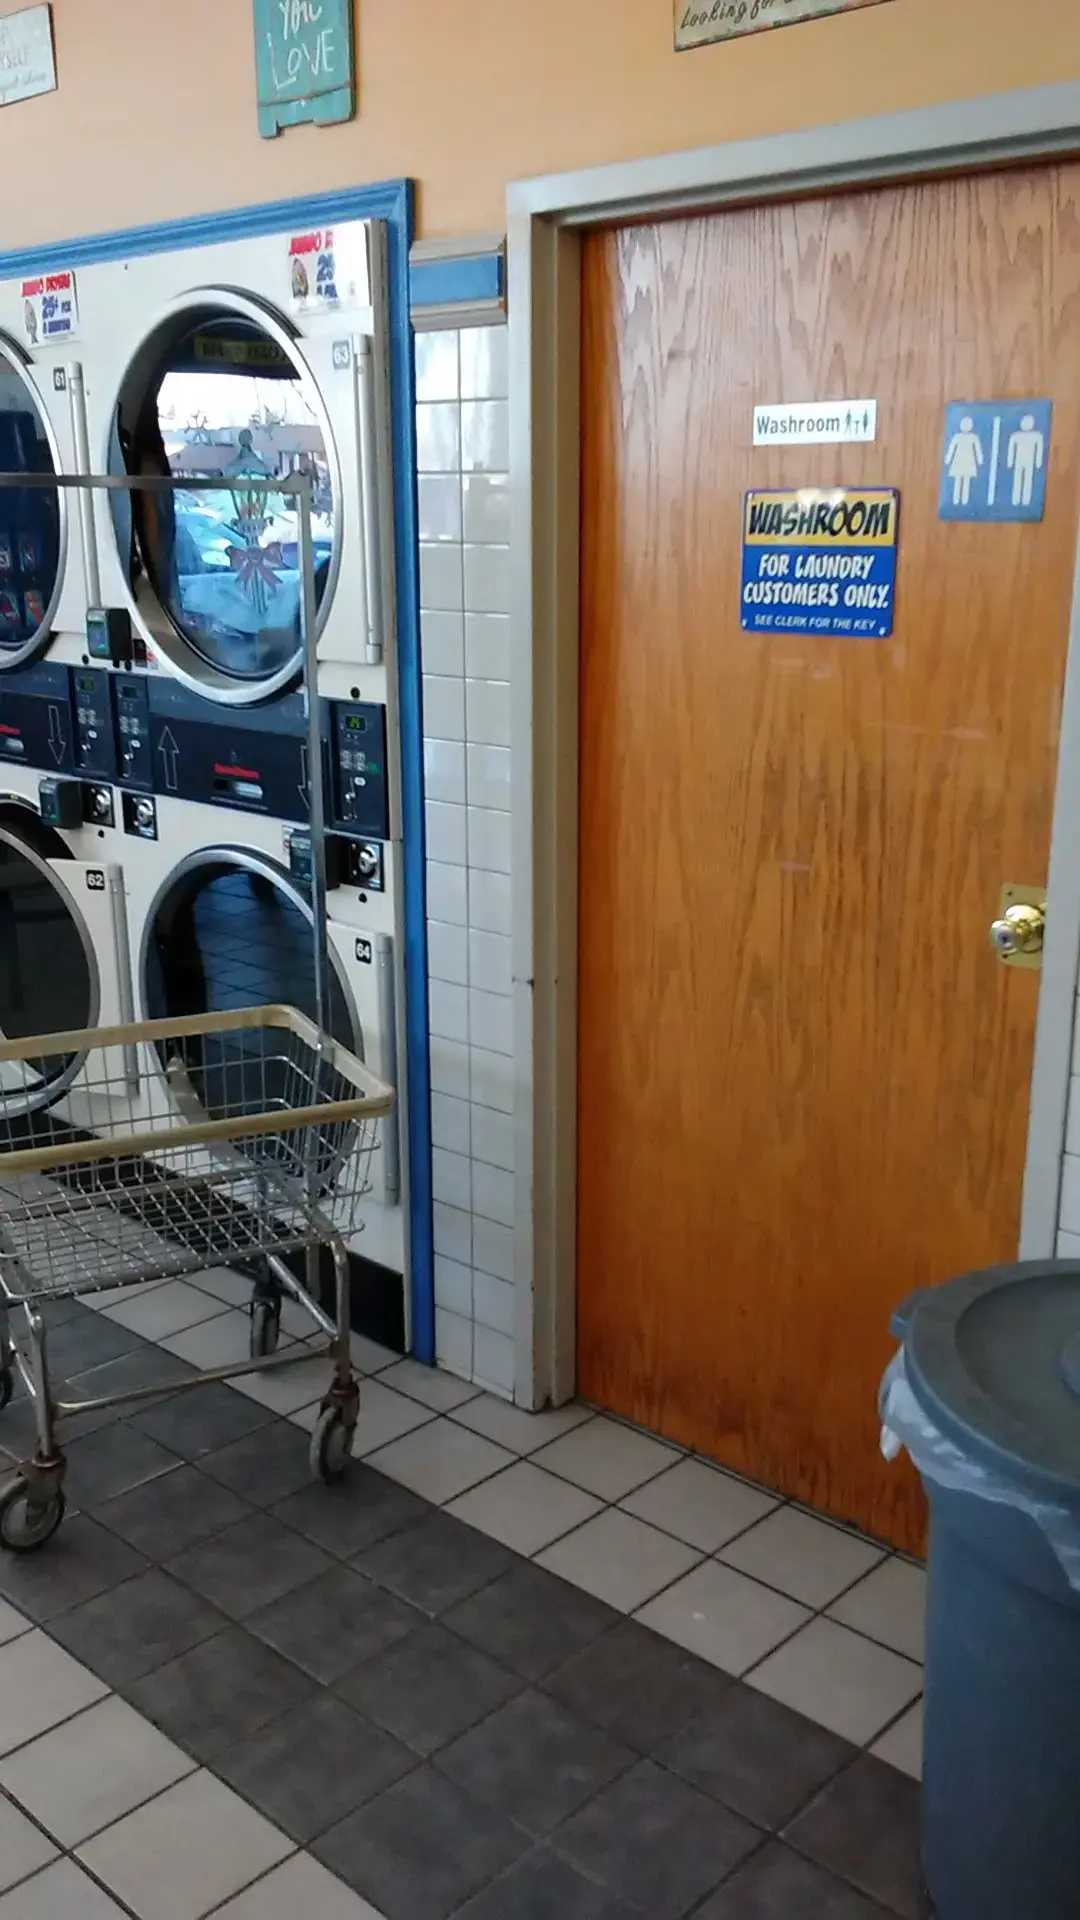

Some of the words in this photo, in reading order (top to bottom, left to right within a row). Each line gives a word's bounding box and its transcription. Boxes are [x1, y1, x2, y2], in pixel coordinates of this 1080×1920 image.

[680, 0, 748, 29] Looking
[266, 28, 335, 90] LOVE
[54, 370, 65, 388] 61
[756, 413, 841, 435] Washroom
[748, 501, 891, 538] WASHROOM
[758, 553, 790, 578] FOR
[794, 554, 876, 581] LAUNDRY
[743, 581, 839, 607] CUSTOMERS
[843, 584, 890, 609] ONLY.
[754, 613, 773, 626] SEE
[774, 615, 808, 628] CLERK
[808, 616, 830, 628] FOR
[831, 617, 852, 630] THE
[853, 618, 877, 631] KEY
[88, 872, 104, 887] 62
[356, 942, 372, 960] 64
